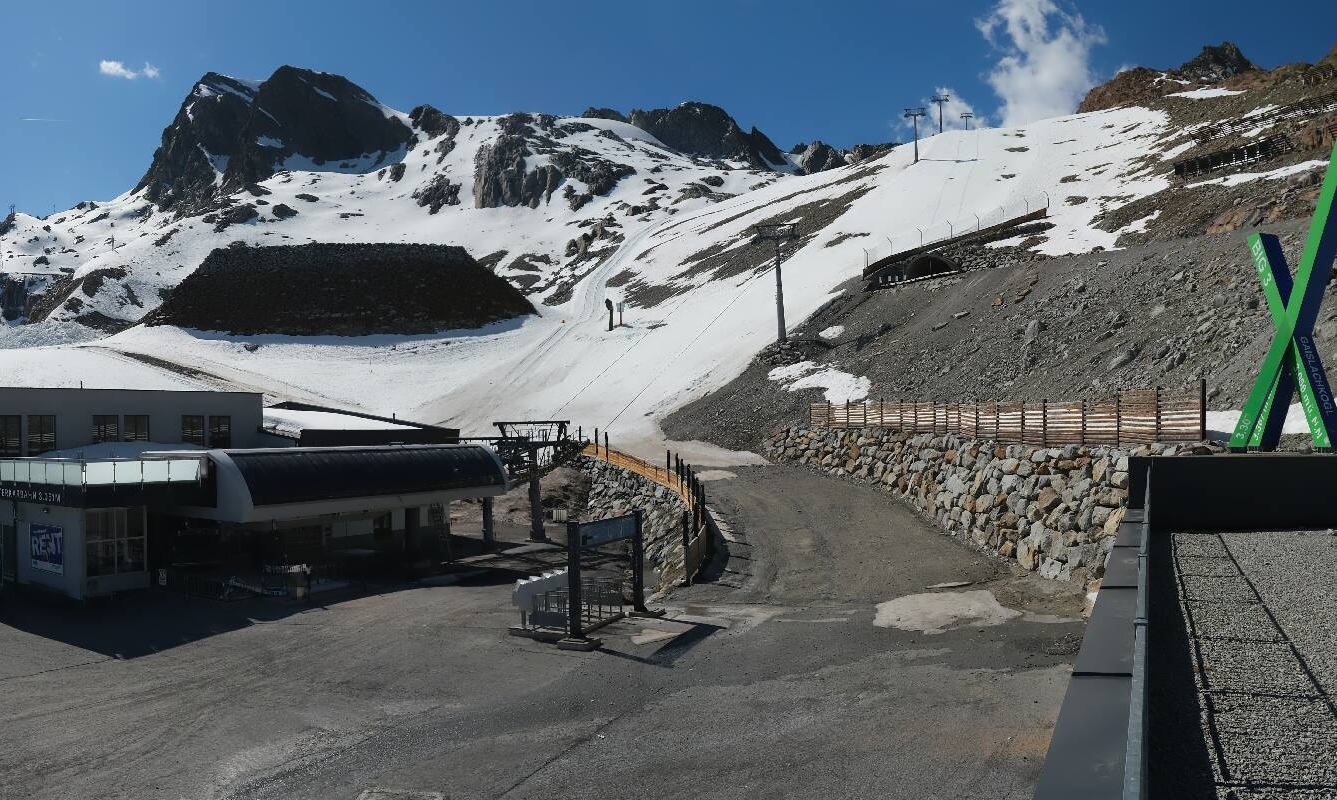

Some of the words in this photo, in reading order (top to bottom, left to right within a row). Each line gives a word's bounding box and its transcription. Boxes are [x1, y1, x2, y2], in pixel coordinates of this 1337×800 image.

[1252, 239, 1267, 273] BIG
[1263, 273, 1272, 287] 3
[1300, 335, 1334, 416] GAISLACHKOGL
[31, 532, 62, 556] RENT
